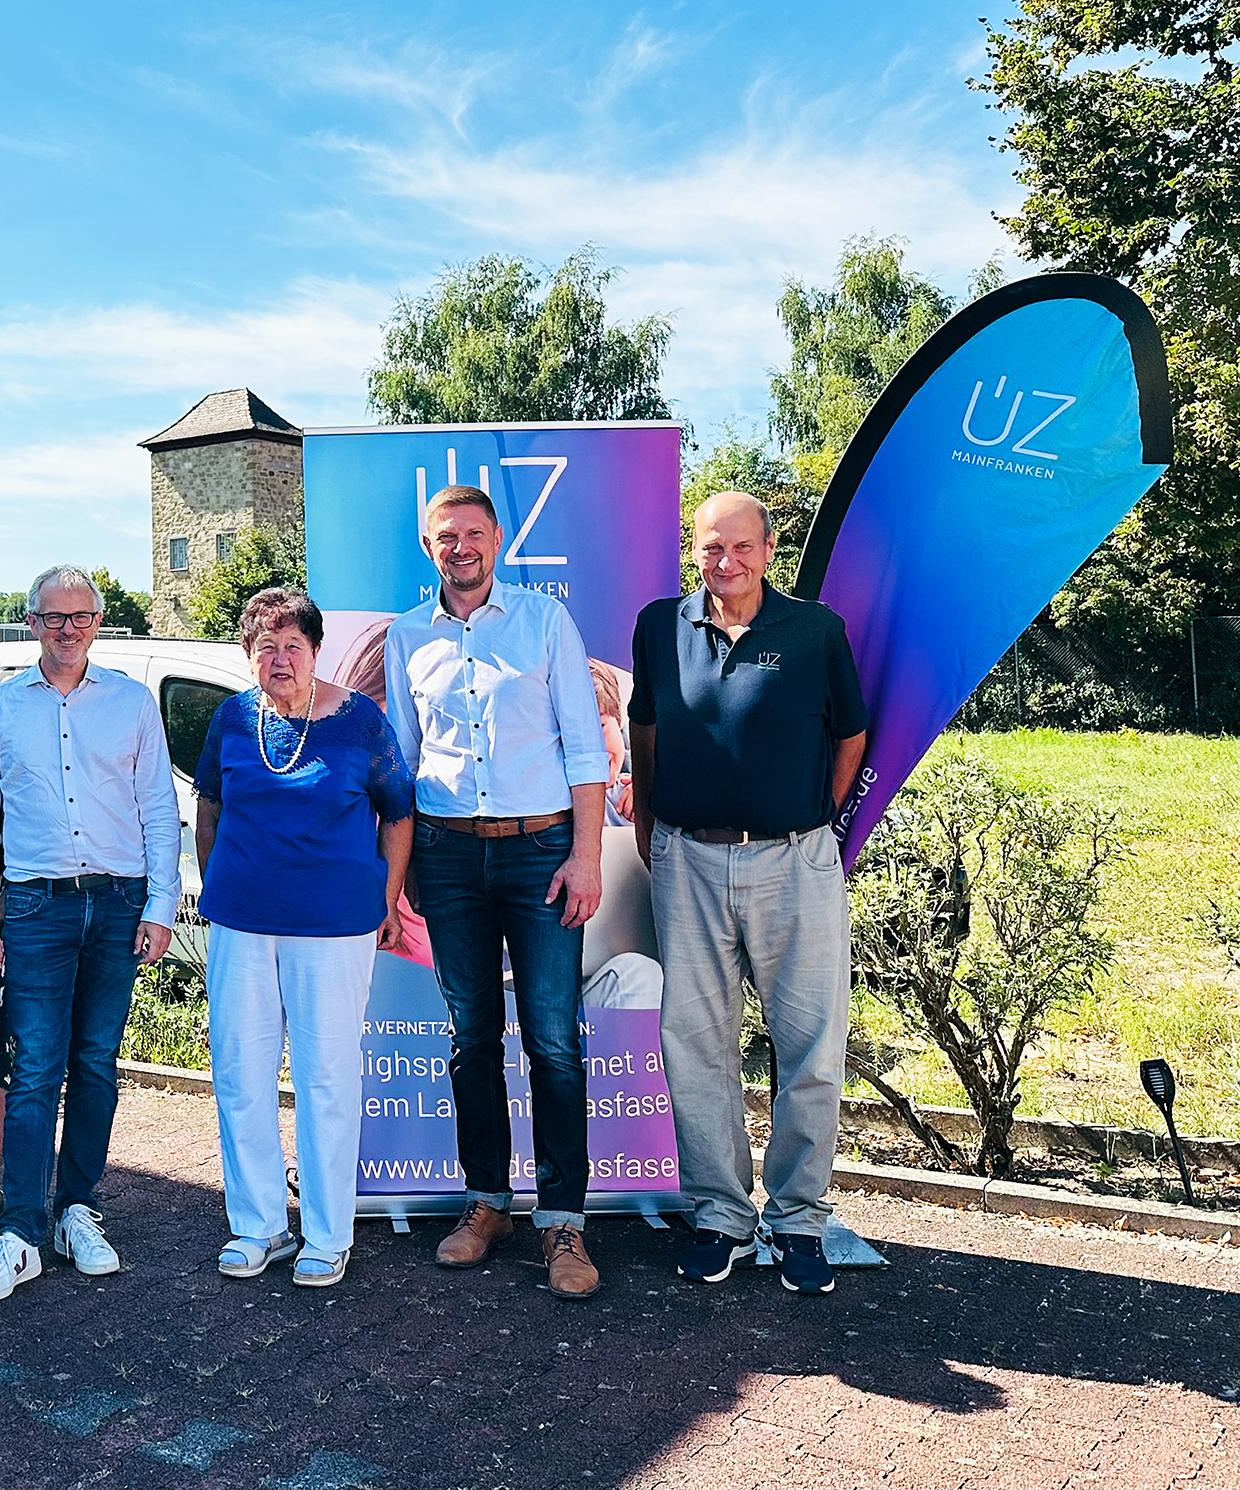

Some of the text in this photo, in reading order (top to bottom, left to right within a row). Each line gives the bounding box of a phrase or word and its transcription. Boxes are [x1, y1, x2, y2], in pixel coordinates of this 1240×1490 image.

[951, 449, 1055, 480] MAINFRANKEN
[375, 1020, 453, 1035] VERNETZ
[586, 1091, 669, 1118] asfase
